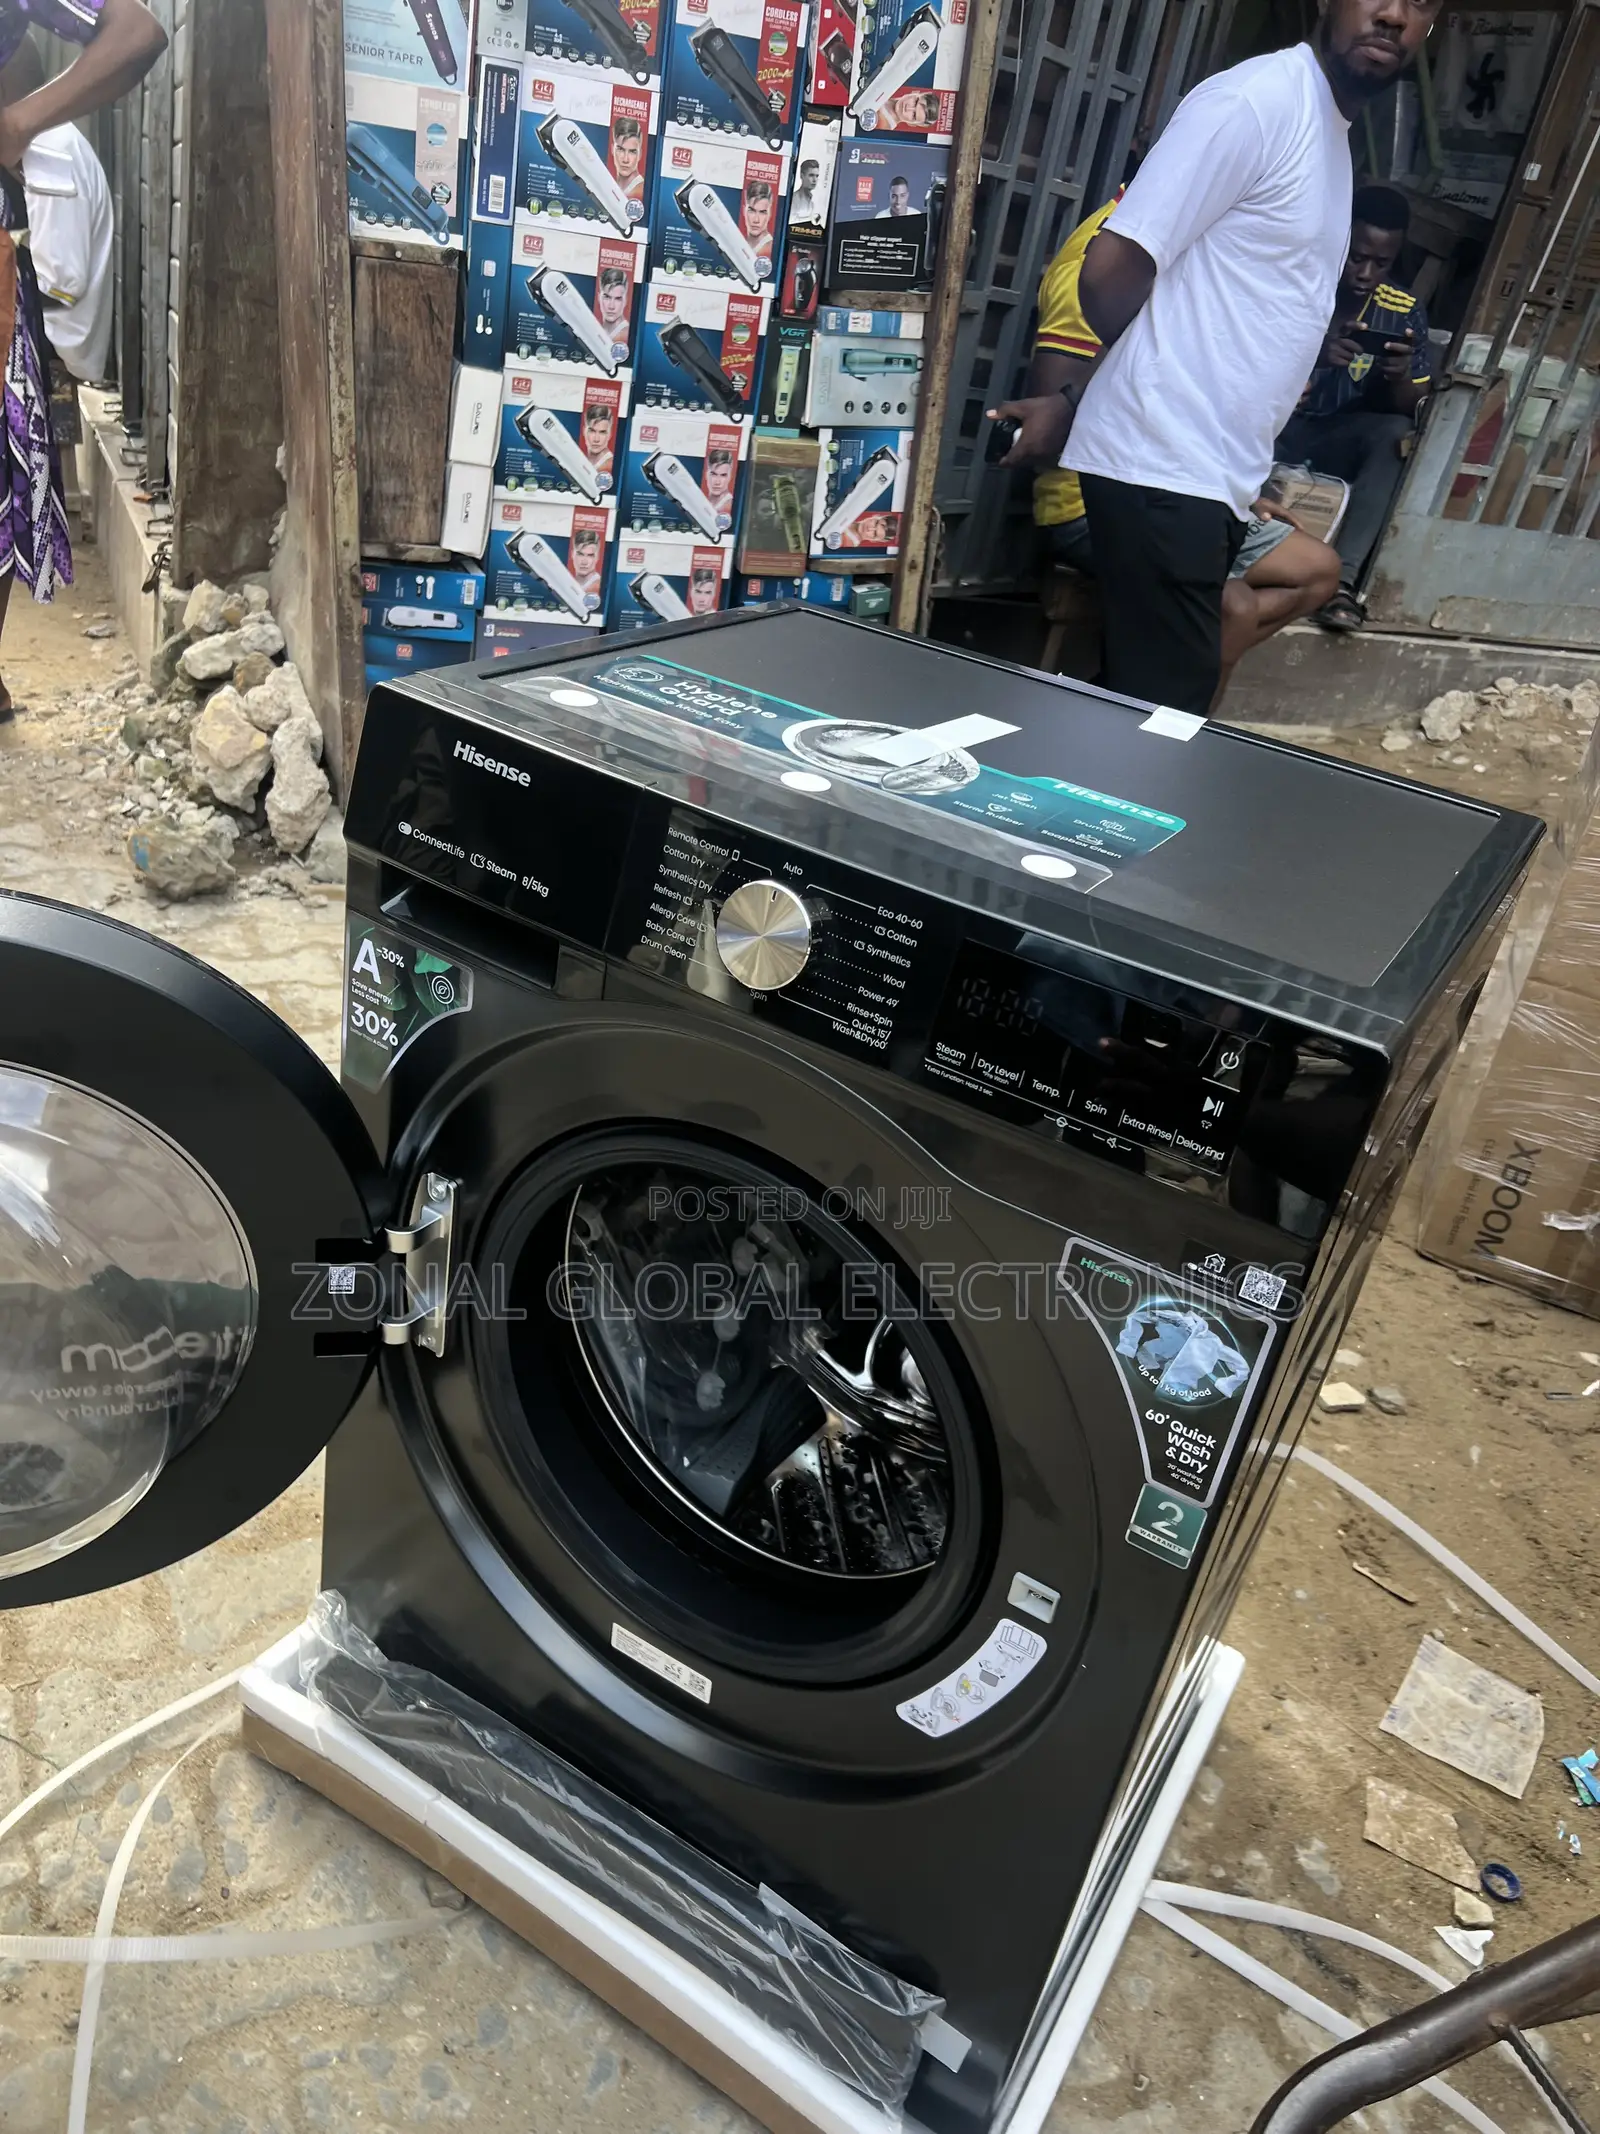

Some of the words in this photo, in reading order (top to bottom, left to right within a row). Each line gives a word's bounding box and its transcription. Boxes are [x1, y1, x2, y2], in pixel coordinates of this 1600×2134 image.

[765, 6, 799, 23] CORDLESS
[345, 42, 386, 60] SENIOR
[388, 50, 424, 67] TAPER
[593, 674, 675, 705] Maintenance
[675, 702, 713, 719] Made
[713, 716, 745, 730] Easy
[658, 686, 743, 717] Guard
[673, 681, 778, 719] Hygiene
[453, 740, 532, 787] Hisense
[1009, 799, 1037, 811] Wash
[1052, 782, 1177, 826] Hisense
[985, 811, 1025, 827] Rubber
[1073, 818, 1104, 830] Drum
[1104, 829, 1137, 843] Clean
[667, 827, 699, 846] Remote
[699, 839, 730, 857] Control
[1040, 829, 1089, 848] Soapbox
[1089, 845, 1122, 859] Clean
[413, 828, 466, 859] ConnectLife
[486, 860, 517, 882] Steam
[522, 876, 550, 898] 8/5kg
[663, 844, 690, 861] Cotton
[690, 854, 706, 869] Dry
[782, 862, 804, 876] Auto
[658, 864, 698, 887] Synthetics
[698, 879, 713, 894] Dry
[653, 883, 682, 902] Refresh
[650, 902, 676, 920] Allergy
[676, 912, 696, 927] Care
[877, 906, 895, 920] Eco
[895, 912, 923, 930] 40-60
[645, 919, 666, 936] Baby
[666, 928, 686, 943] Care
[886, 930, 918, 948] Cotton
[640, 935, 663, 951] Drum
[663, 944, 687, 961] Clean
[866, 944, 912, 968] Synthetics
[352, 937, 382, 985] A
[376, 947, 405, 969] -30%
[351, 977, 368, 991] Save
[883, 973, 906, 990] Wool
[351, 985, 365, 998] Less
[365, 994, 380, 1006] cost
[750, 989, 768, 1002] Spin
[858, 986, 886, 1004] Power
[350, 1001, 399, 1047] 30%
[846, 1002, 893, 1028] Rinse+Spin
[852, 1018, 877, 1037] Quick
[935, 1042, 967, 1061] Steam
[977, 1058, 995, 1073] Dry
[994, 1063, 1020, 1082] Level
[1032, 1079, 1061, 1098] Temp.
[1084, 1100, 1108, 1116] Spin
[1122, 1114, 1147, 1131] Extra
[1146, 1125, 1173, 1141] Rinse
[1176, 1135, 1204, 1154] Delay
[1204, 1147, 1225, 1161] End
[1079, 1256, 1135, 1288] Hisense
[1138, 1364, 1150, 1377] Up
[1149, 1375, 1159, 1386] to
[1164, 1385, 1177, 1396] kg
[1189, 1388, 1212, 1398] load
[1167, 1431, 1212, 1461] Wash
[1170, 1420, 1217, 1449] Quick
[1165, 1446, 1177, 1459] &
[1178, 1452, 1209, 1475] Dry
[1176, 1466, 1204, 1485] washing
[1179, 1476, 1201, 1491] drying
[1151, 1501, 1184, 1539] 2
[1139, 1528, 1183, 1553] WARRANTY
